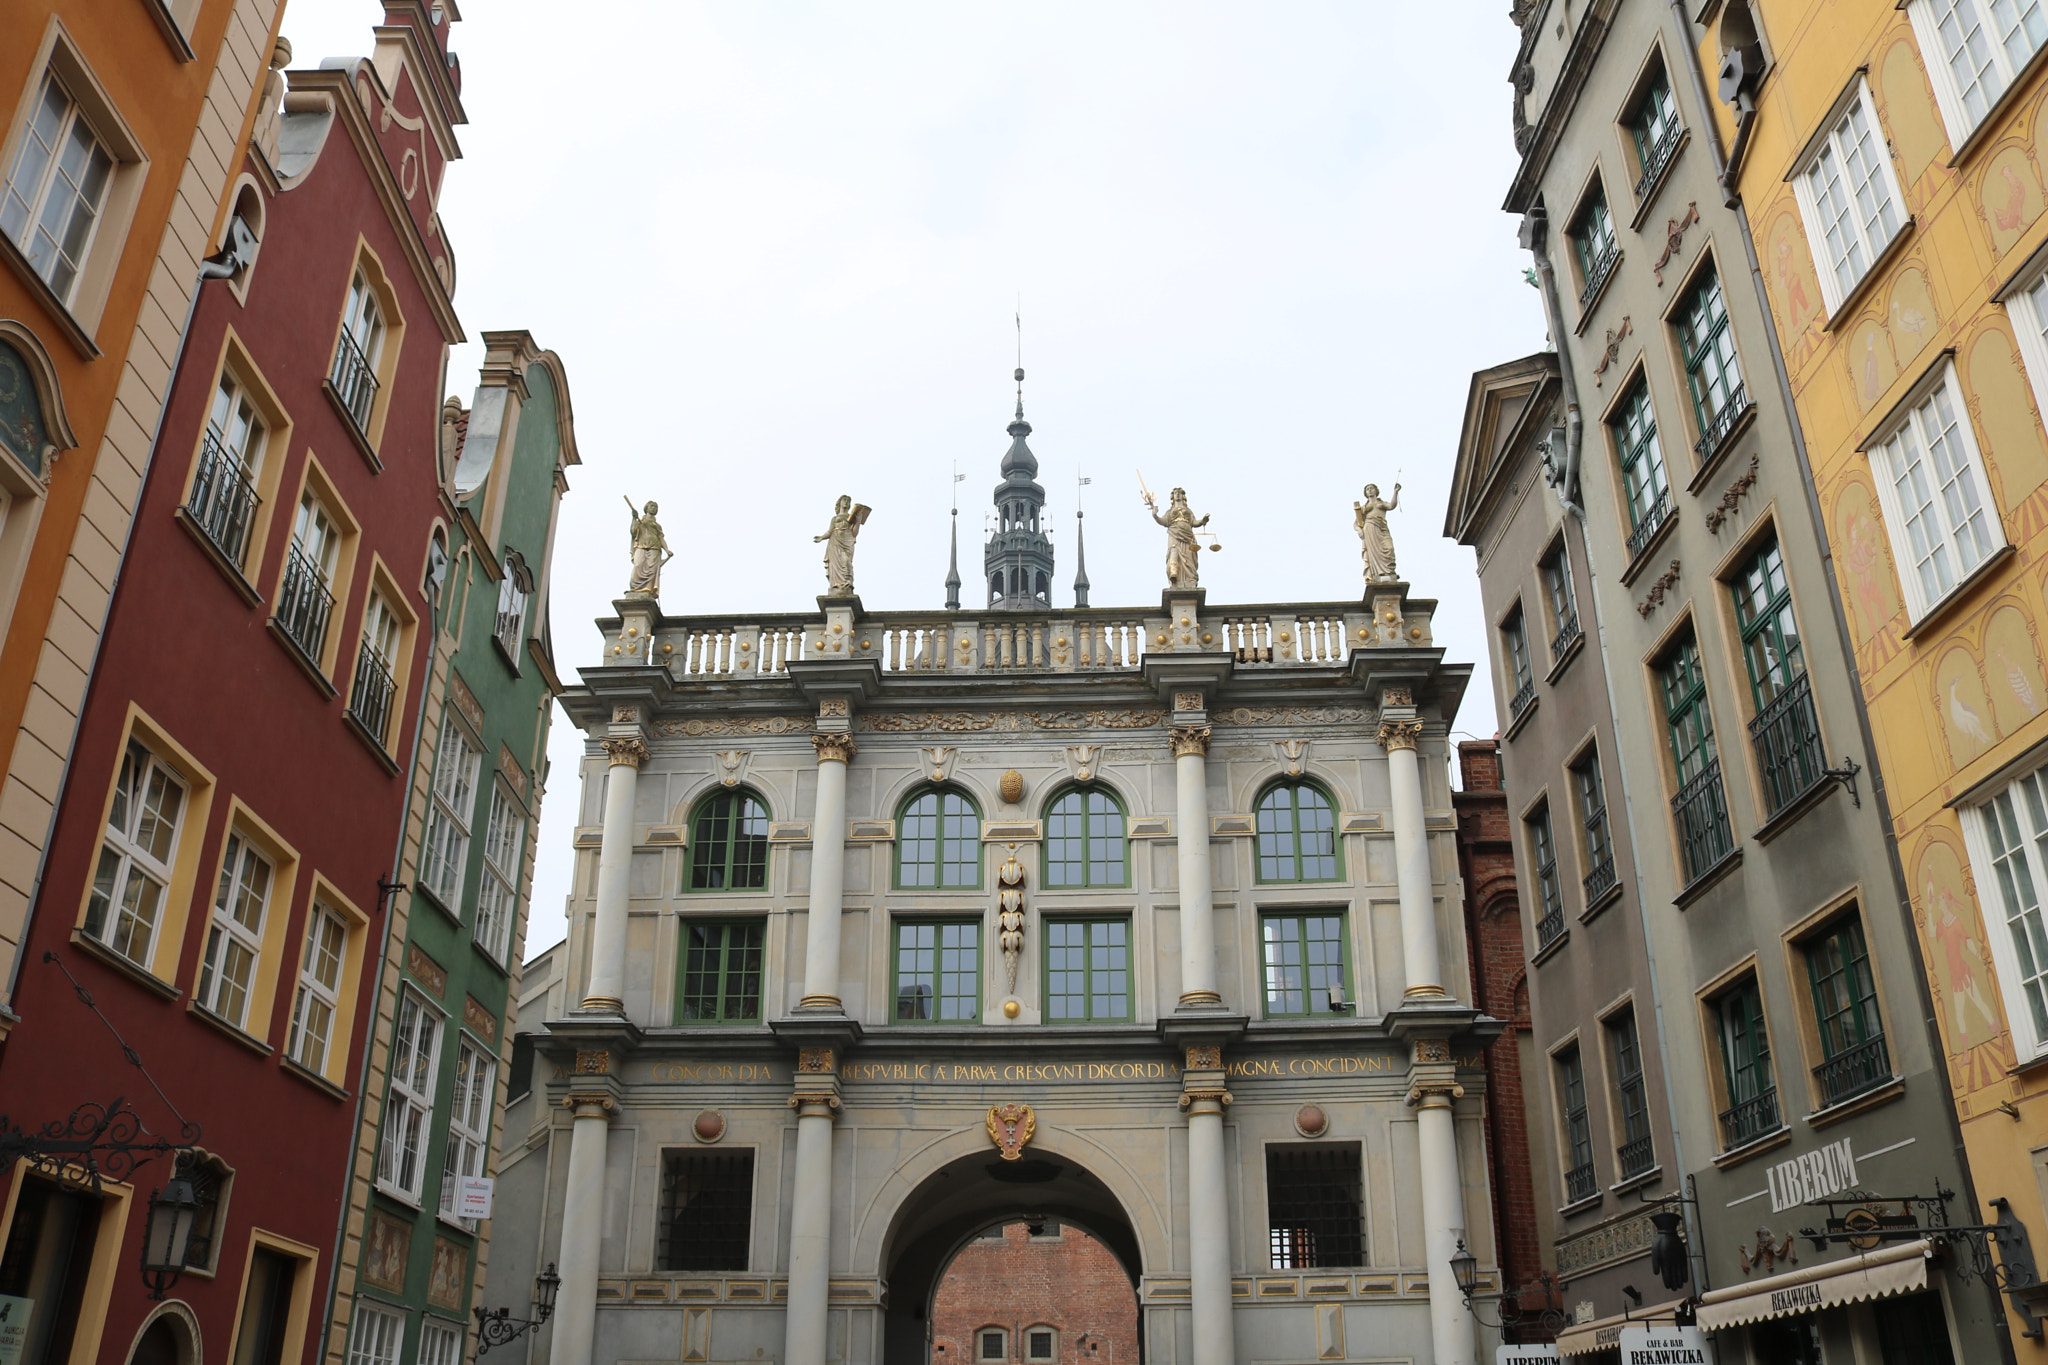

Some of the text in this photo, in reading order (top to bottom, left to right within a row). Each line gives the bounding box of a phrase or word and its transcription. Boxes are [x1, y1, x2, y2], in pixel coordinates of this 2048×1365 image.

[652, 1062, 772, 1080] CONCORDIA
[1004, 1064, 1087, 1080] CRESCVNT
[1289, 1056, 1397, 1075] CONCIDVNT
[1766, 1137, 1859, 1213] LIBERUM
[1771, 1284, 1822, 1312] RĘKAWICZKA
[1646, 1339, 1684, 1348] CAFE & BAR
[1630, 1349, 1704, 1365] RĘKAWICZKA
